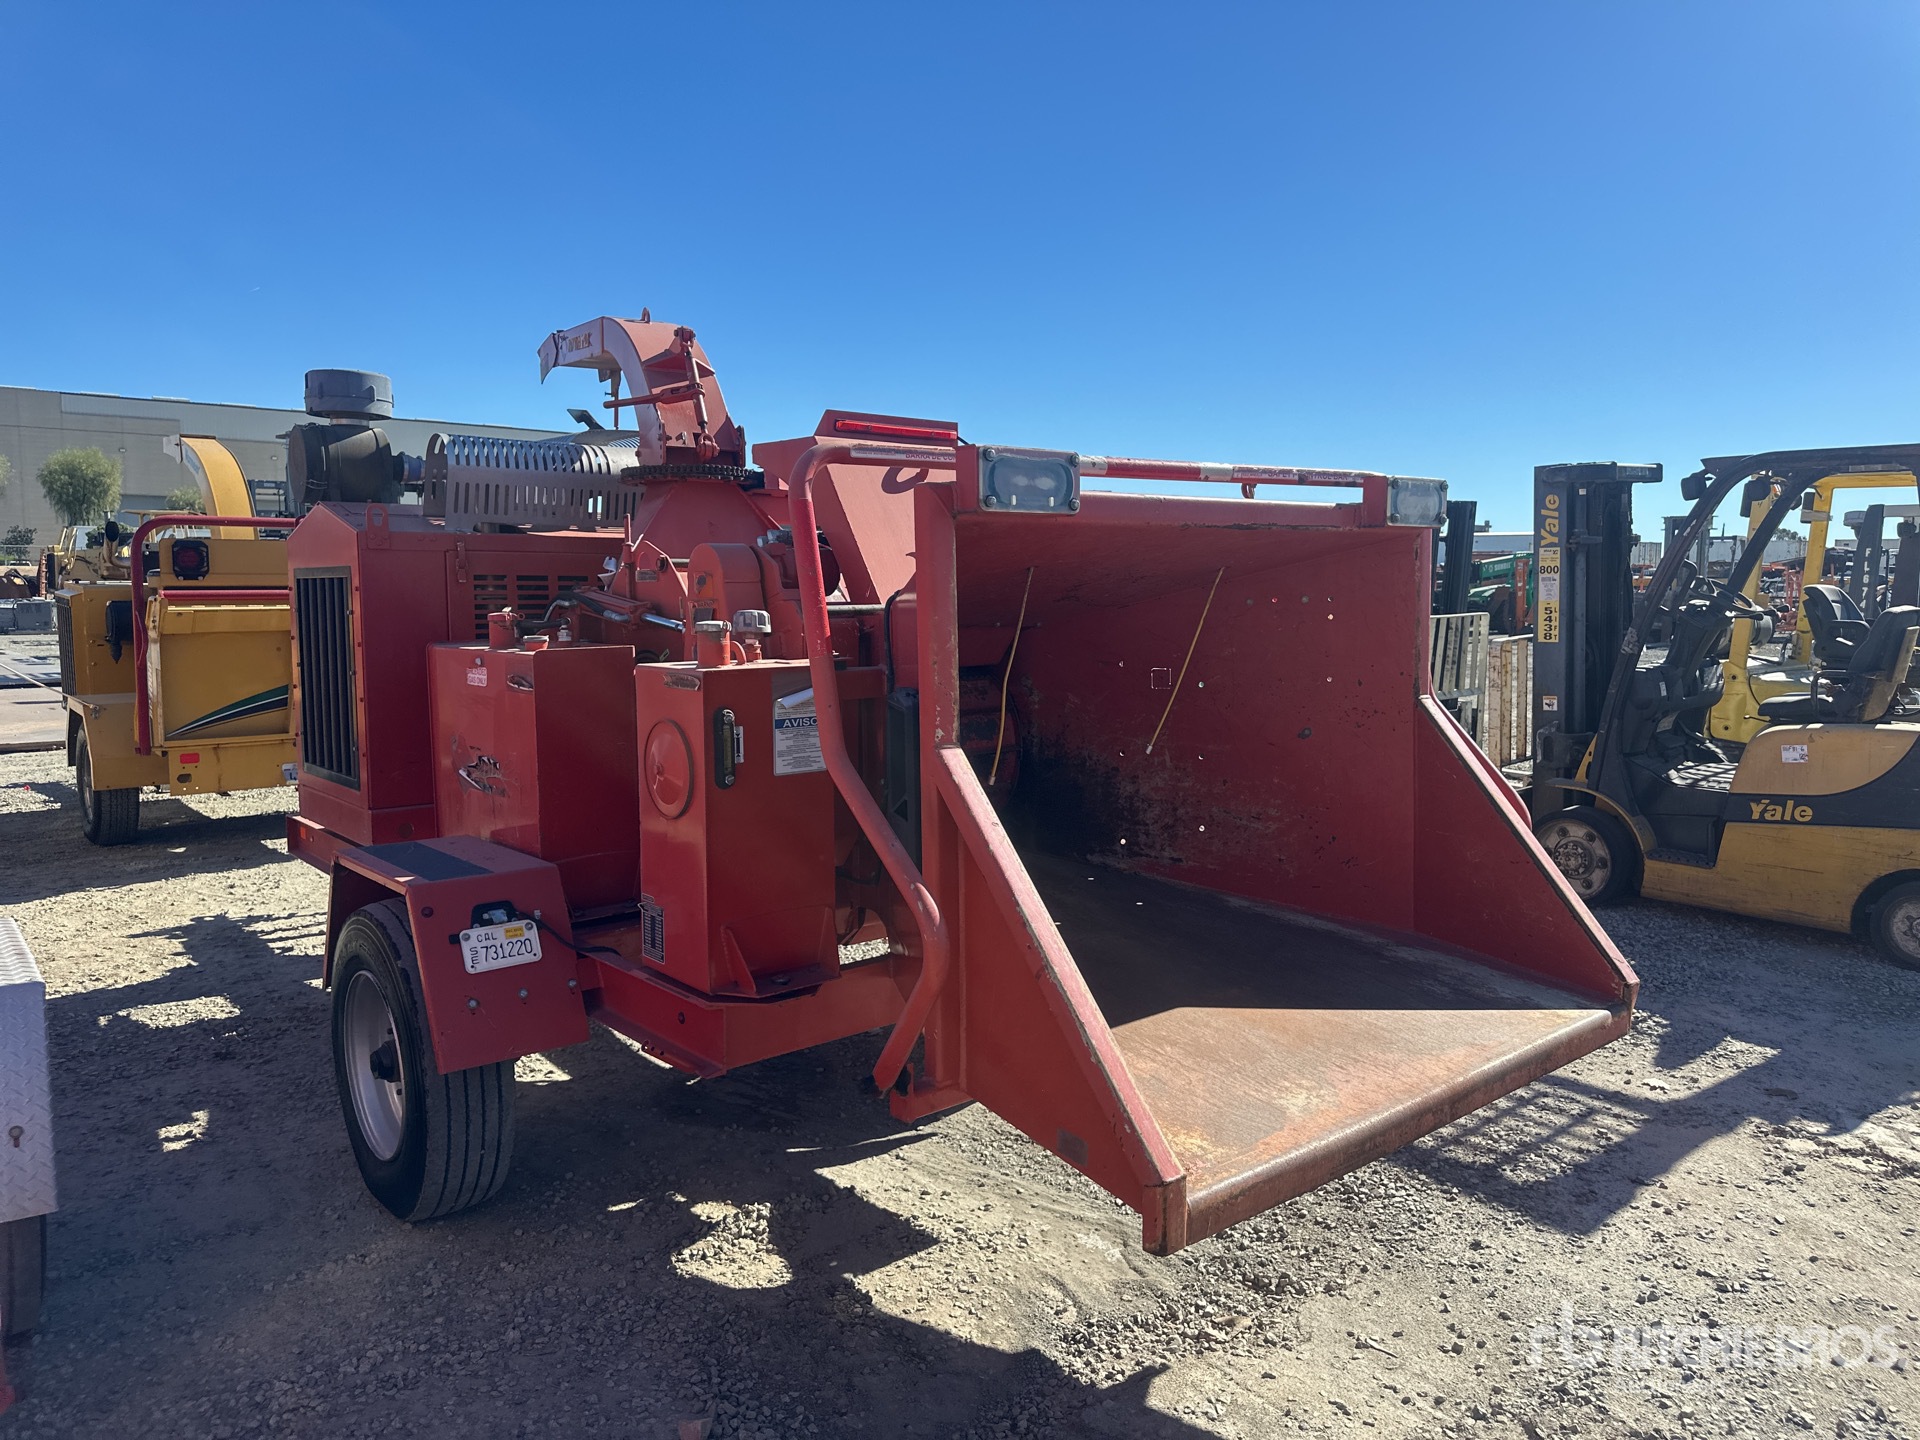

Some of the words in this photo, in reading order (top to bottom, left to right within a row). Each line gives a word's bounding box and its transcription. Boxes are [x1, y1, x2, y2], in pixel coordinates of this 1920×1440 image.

[1540, 494, 1560, 546] Yale
[1539, 565, 1559, 575] 800
[1749, 799, 1813, 822] Yale
[476, 932, 498, 943] CAL
[480, 938, 533, 963] 731220
